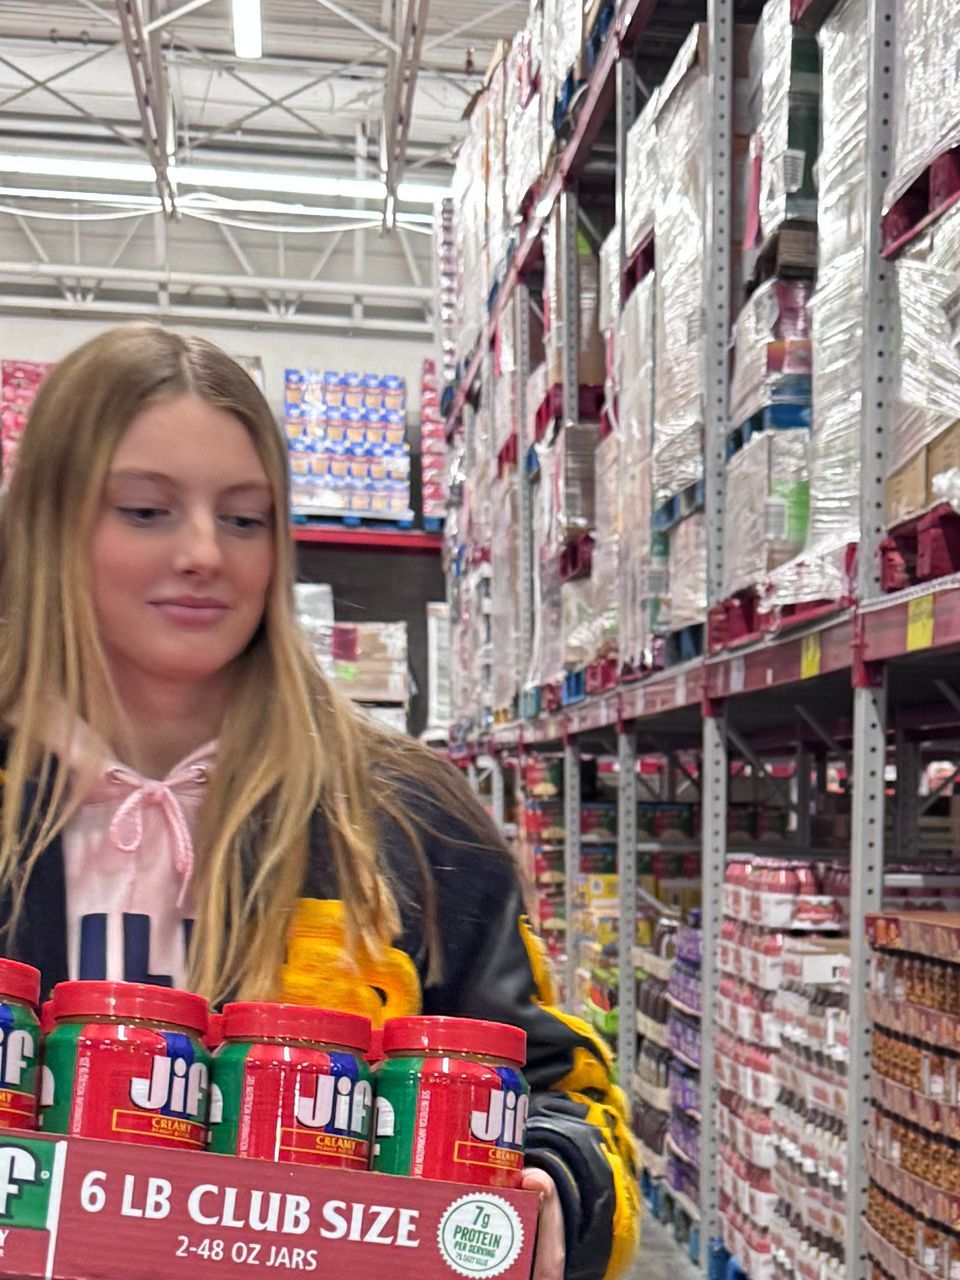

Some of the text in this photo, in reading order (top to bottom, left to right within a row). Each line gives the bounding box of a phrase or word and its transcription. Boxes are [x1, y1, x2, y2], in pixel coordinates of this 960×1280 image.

[128, 1055, 210, 1117] Jif
[295, 1074, 373, 1135] Jif
[151, 1118, 192, 1133] CREAMY
[315, 1135, 356, 1151] CREAMY
[80, 1170, 420, 1248] 6 LB CLUB SIZE
[475, 1205, 491, 1229] 7g
[453, 1226, 502, 1248] PROTEIN
[175, 1235, 318, 1271] 2-48 OZ JARS
[454, 1240, 496, 1259] PER SERVING
